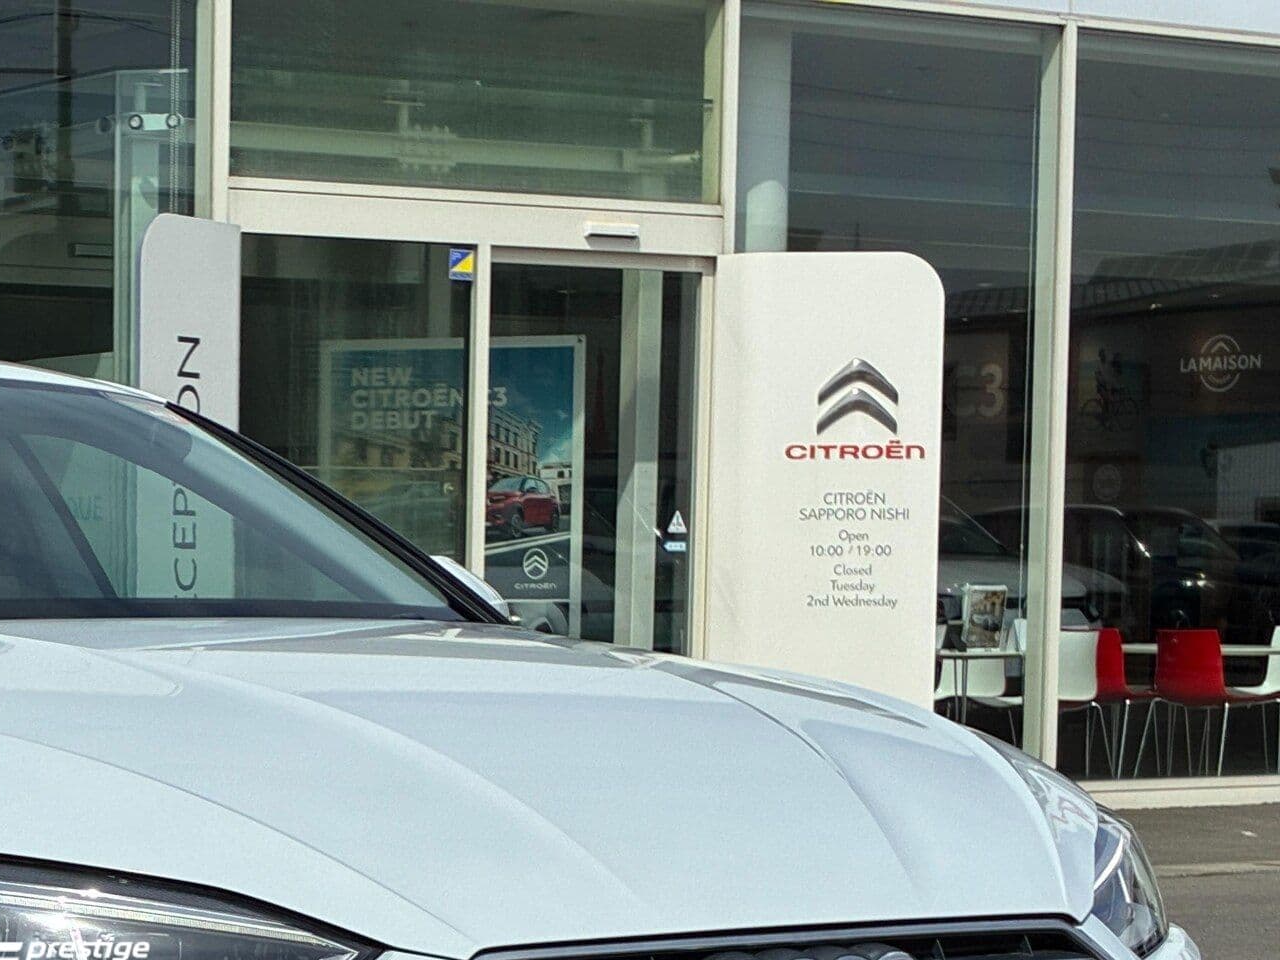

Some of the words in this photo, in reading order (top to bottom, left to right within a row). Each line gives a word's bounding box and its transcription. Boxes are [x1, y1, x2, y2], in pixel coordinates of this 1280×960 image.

[350, 367, 412, 386] NEW
[350, 410, 438, 430] DEBUT
[799, 507, 867, 521] SAPPORO
[870, 508, 910, 520] NISHI
[838, 529, 869, 543] Open
[810, 545, 843, 556] 10:00
[857, 544, 892, 556] 19:00
[833, 563, 872, 576] Closed
[830, 578, 875, 594] Tuesday
[806, 594, 829, 607] 2nd
[832, 594, 898, 609] Wednesday
